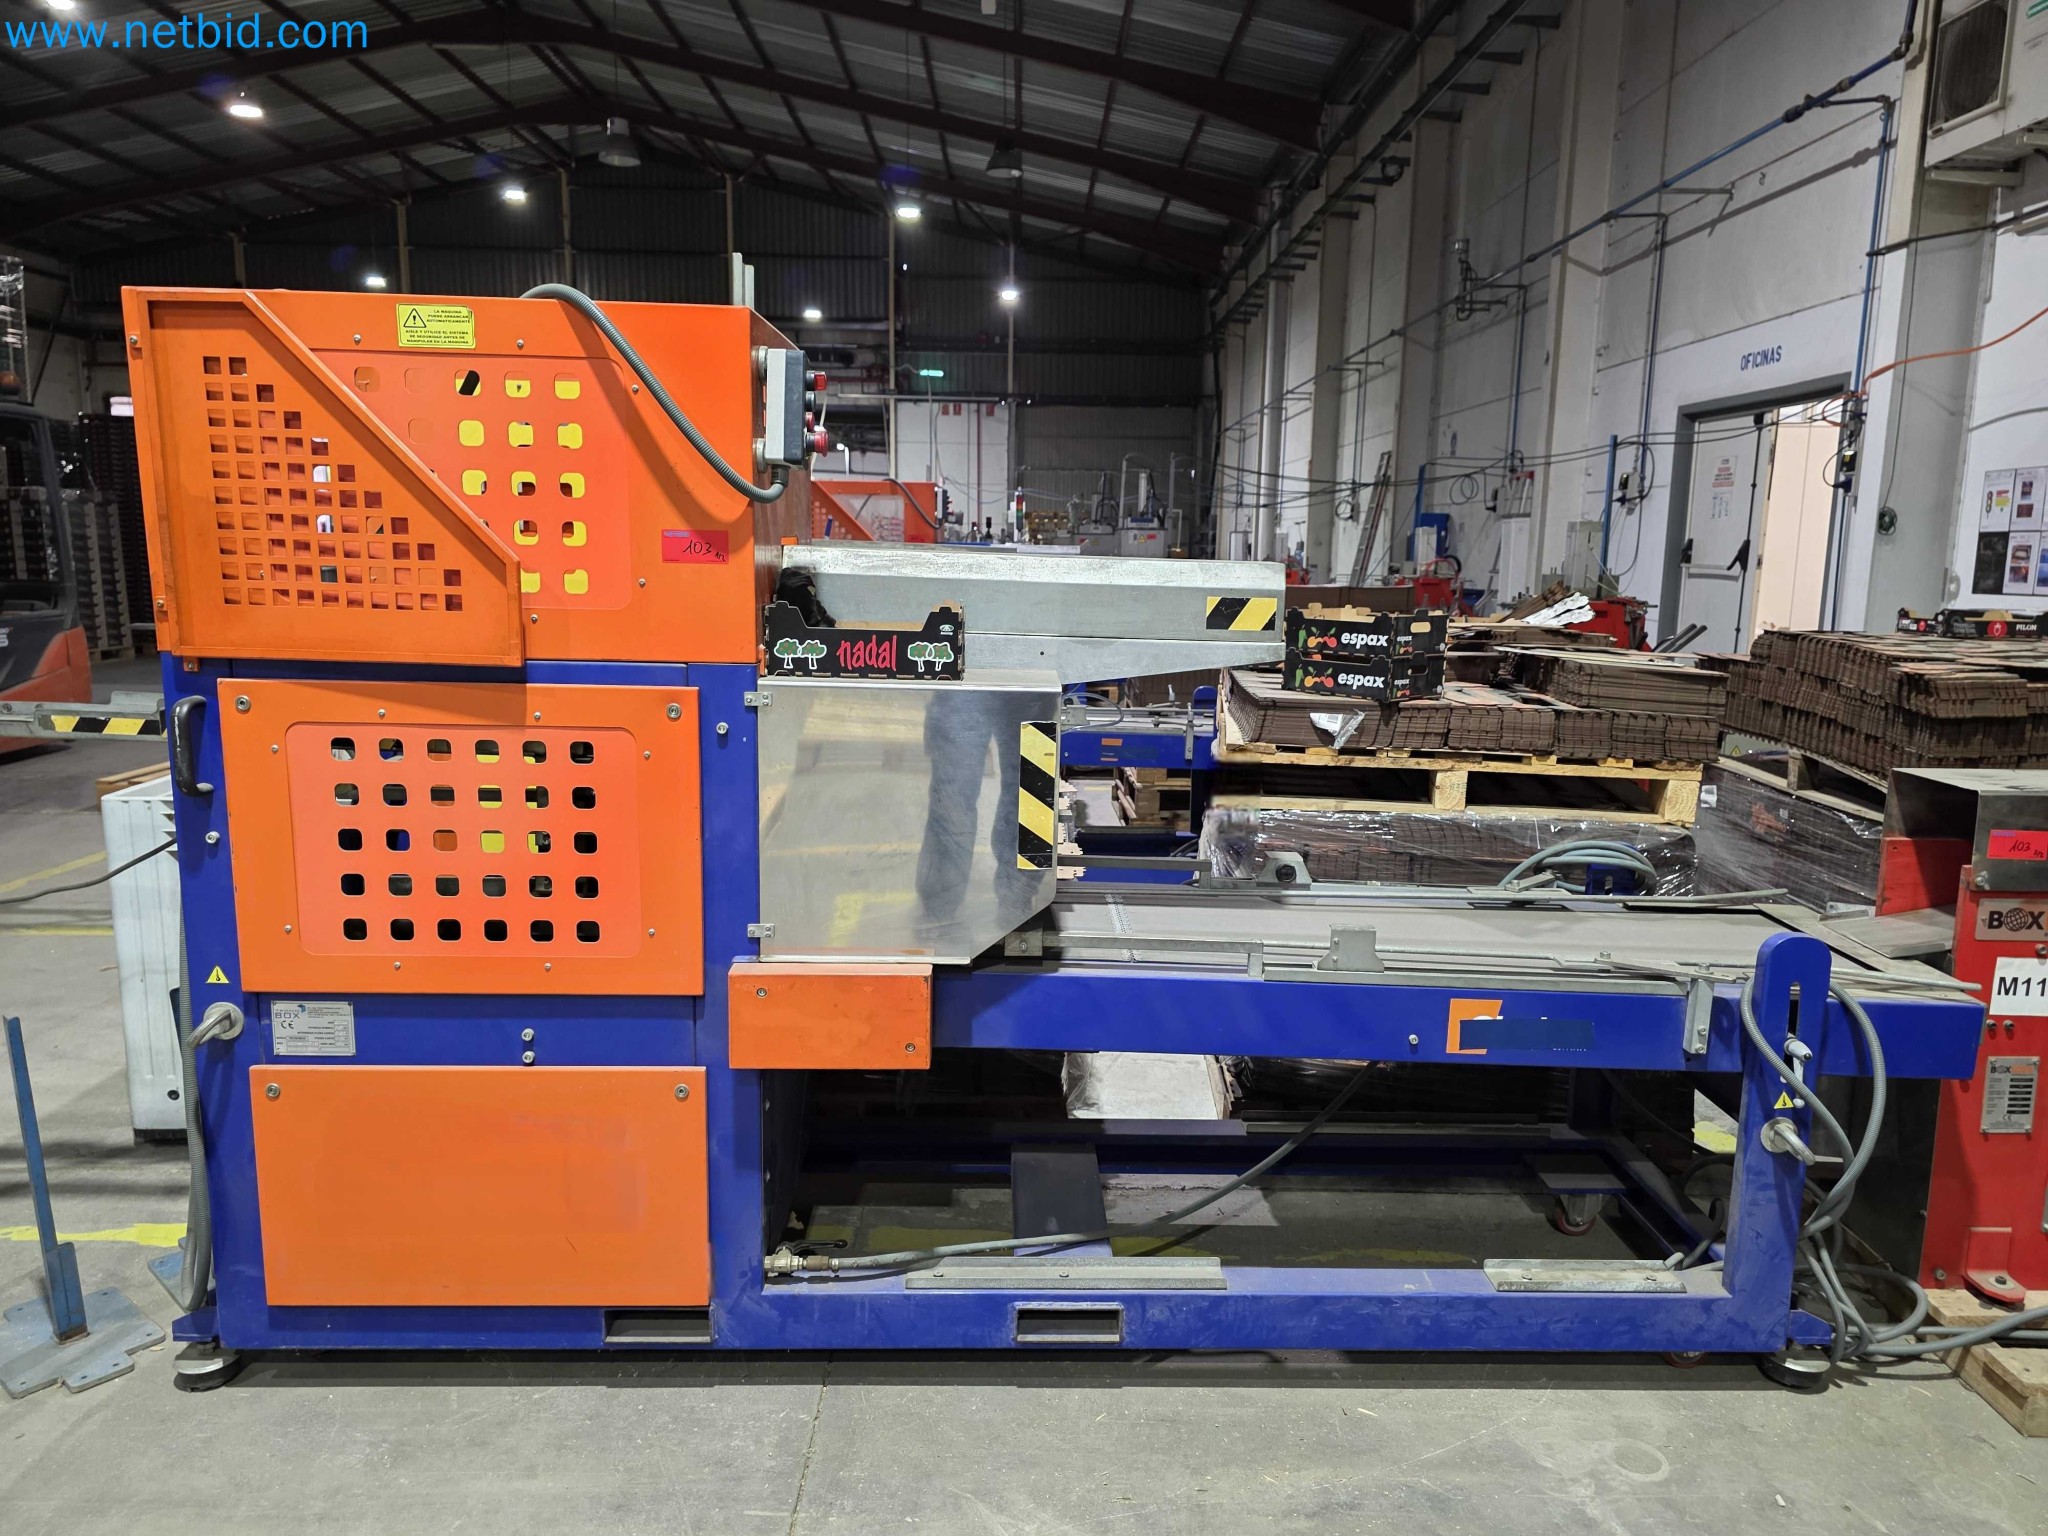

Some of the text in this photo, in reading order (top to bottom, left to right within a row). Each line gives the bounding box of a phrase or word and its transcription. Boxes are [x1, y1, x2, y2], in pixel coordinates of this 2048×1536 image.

[1740, 345, 1782, 371] OFICINAS
[683, 539, 712, 556] 103
[1340, 632, 1389, 649] espax
[836, 634, 897, 672] nadal
[1337, 672, 1386, 690] espax
[2008, 840, 2031, 852] 103
[1997, 976, 2047, 997] M11
